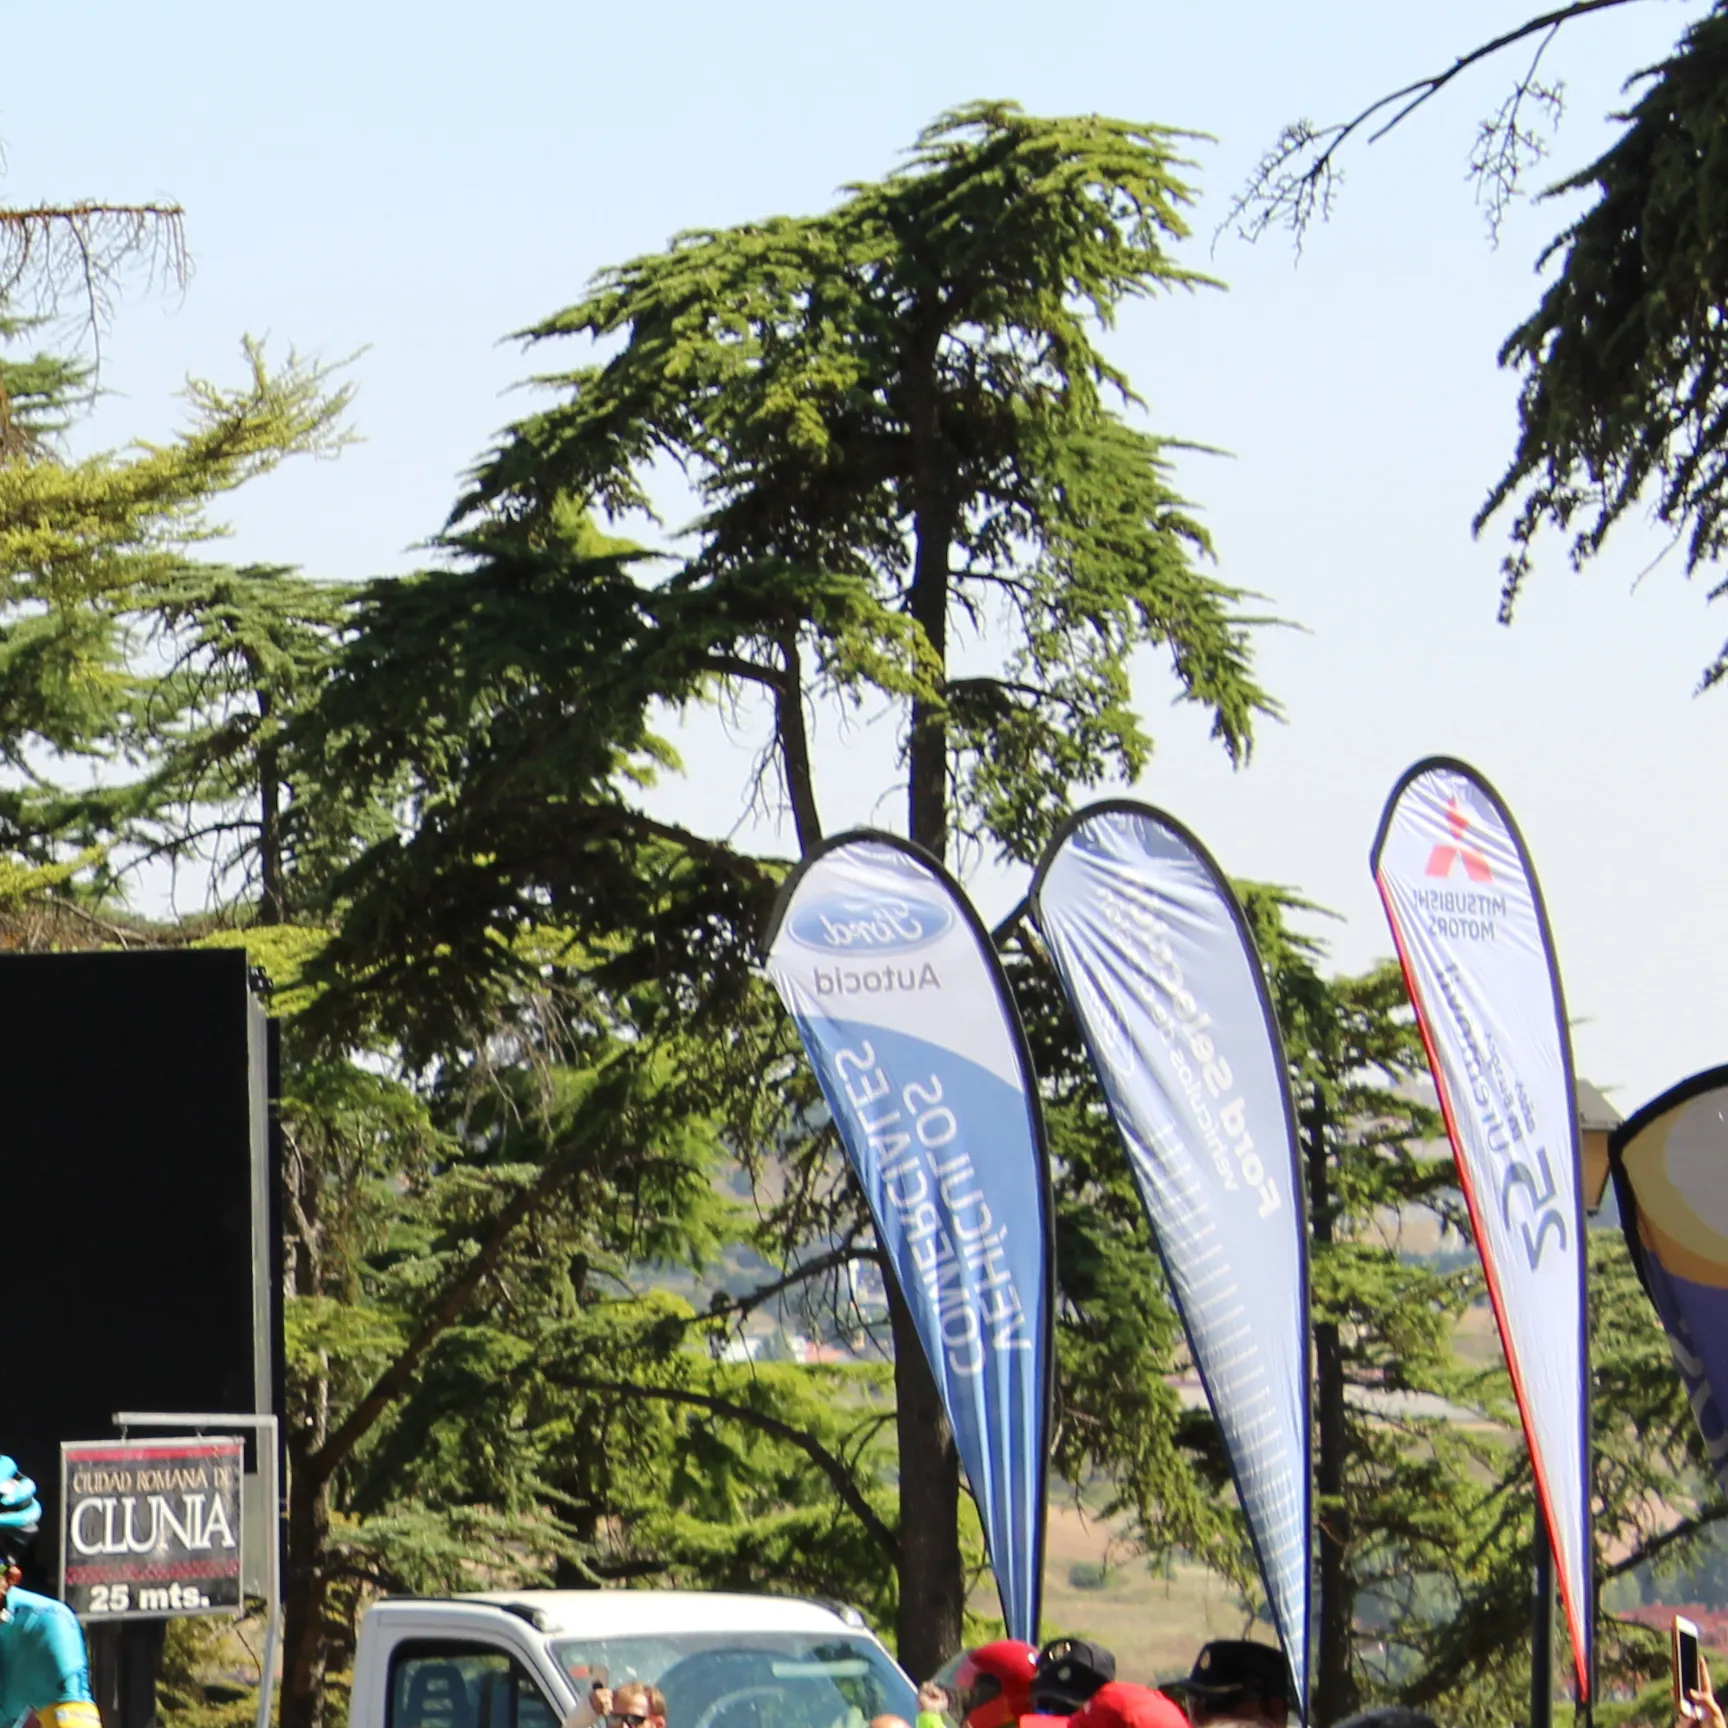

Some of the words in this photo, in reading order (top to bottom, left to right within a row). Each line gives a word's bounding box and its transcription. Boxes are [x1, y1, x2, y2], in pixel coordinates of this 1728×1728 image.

[72, 1468, 134, 1495] CIUDAD
[136, 1466, 208, 1493] ROMANA
[70, 1492, 237, 1556] CLUNIA
[90, 1585, 130, 1613] 25
[139, 1585, 210, 1611] mts.
